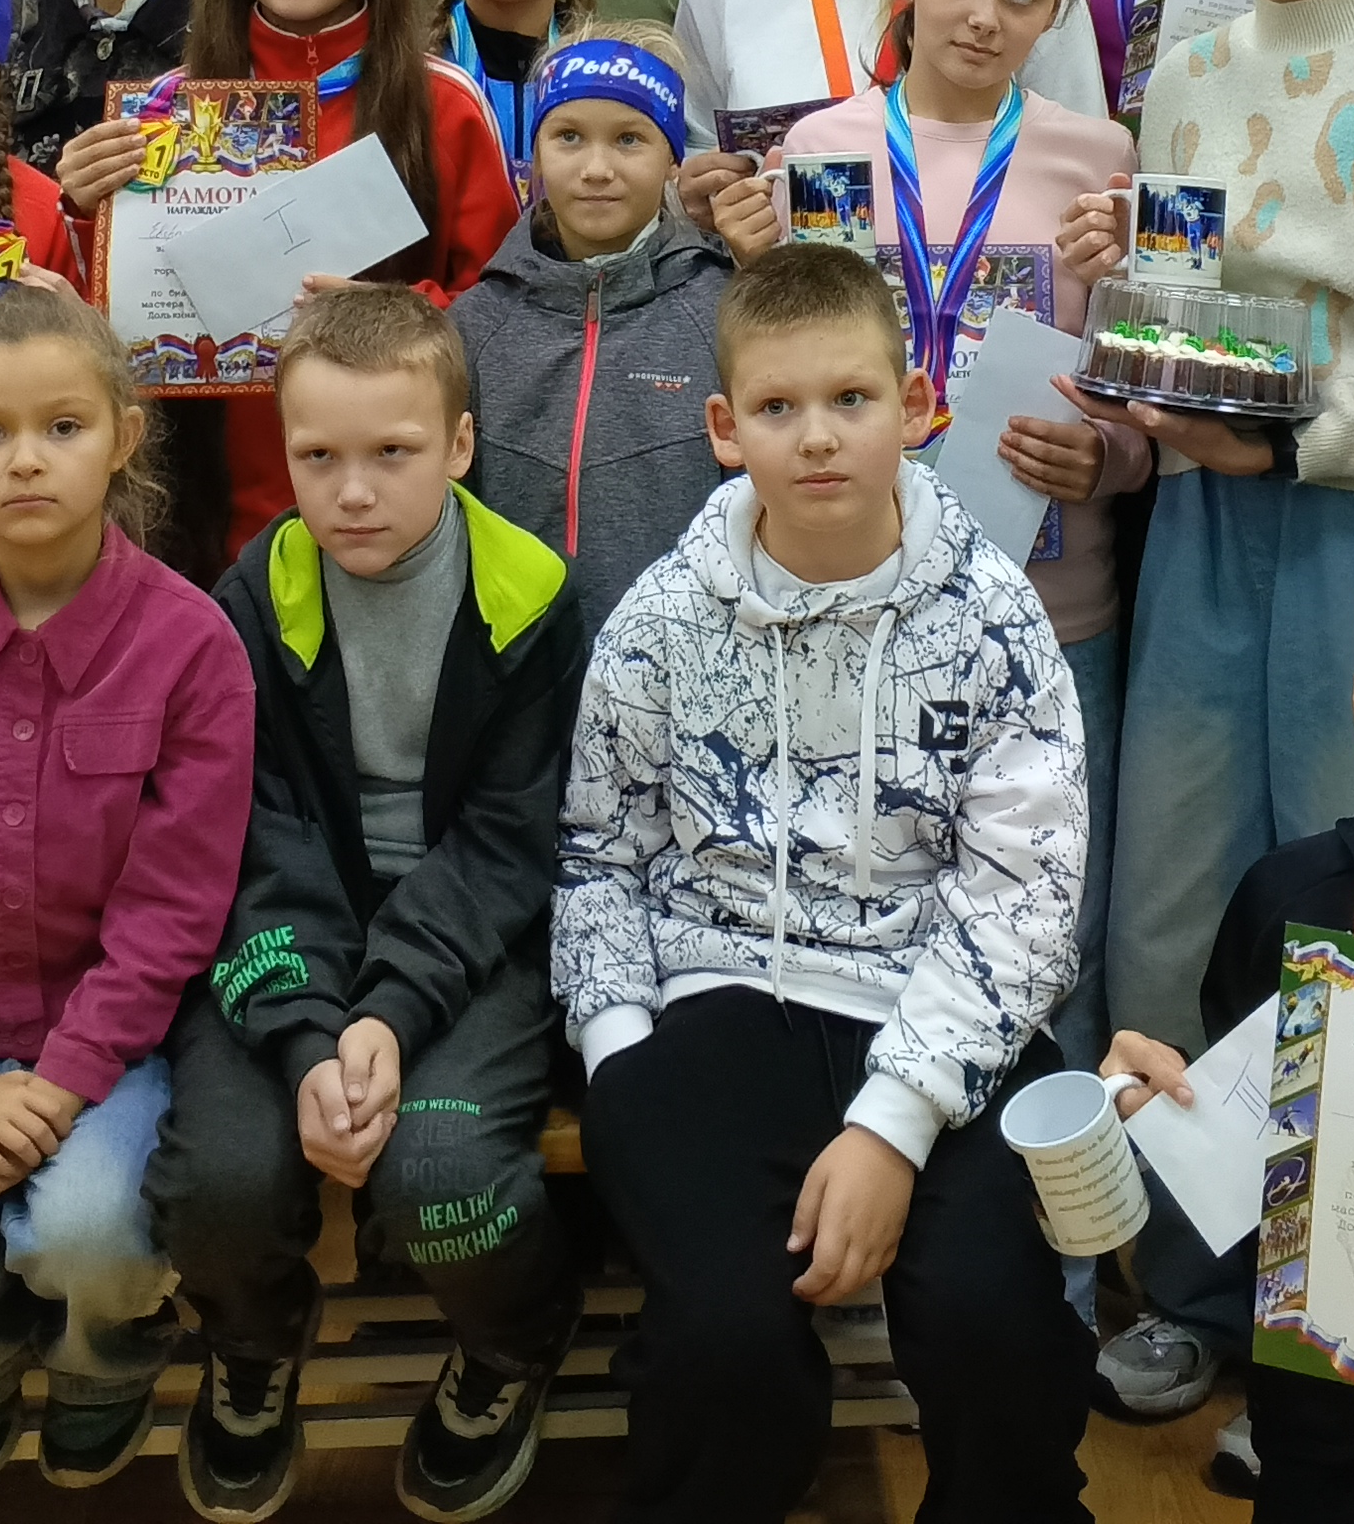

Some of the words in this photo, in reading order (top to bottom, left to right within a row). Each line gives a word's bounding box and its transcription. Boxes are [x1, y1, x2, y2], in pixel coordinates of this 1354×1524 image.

[561, 57, 679, 113] Рыбинск
[154, 145, 167, 168] 1
[141, 301, 184, 310] мастера
[419, 1182, 496, 1231] HEALTHY
[406, 1205, 519, 1265] WORKHARD
